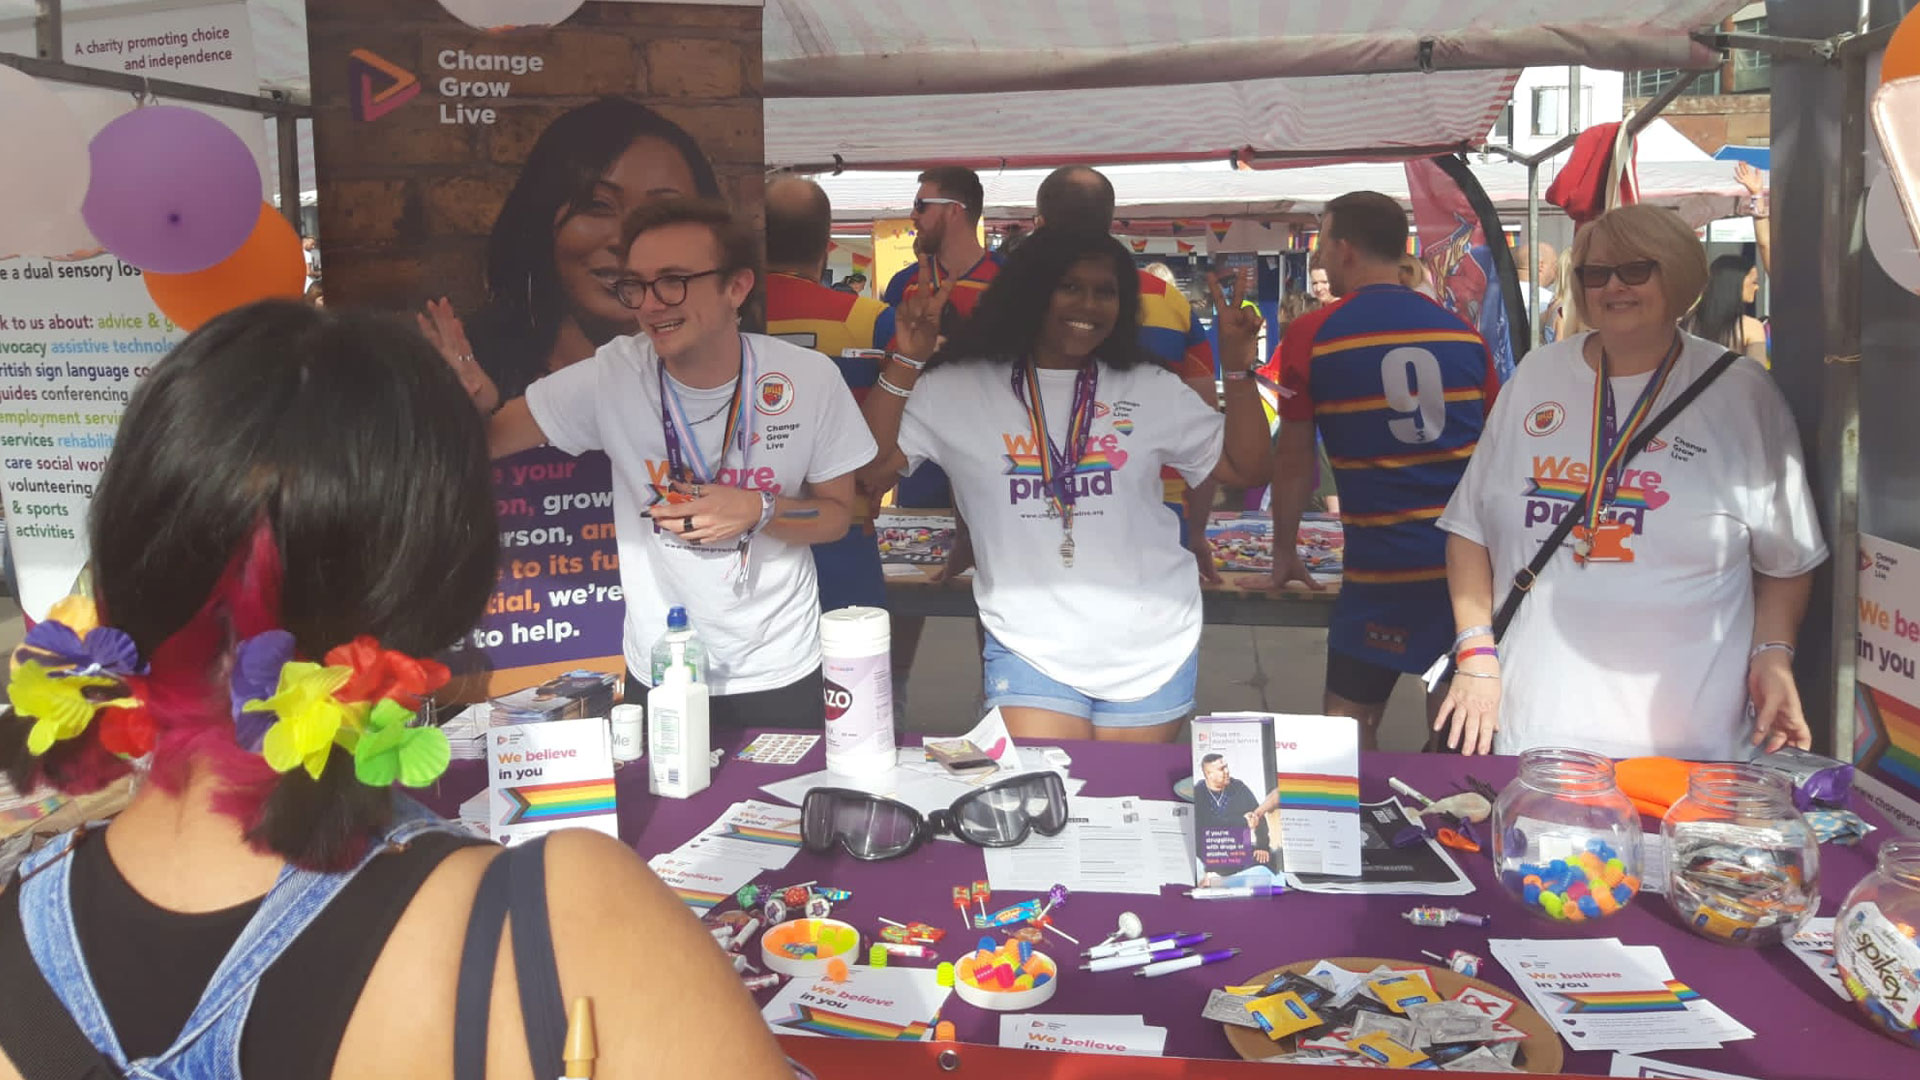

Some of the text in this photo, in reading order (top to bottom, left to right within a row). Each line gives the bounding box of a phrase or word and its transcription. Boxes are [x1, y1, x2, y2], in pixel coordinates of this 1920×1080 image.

[75, 26, 230, 55] A charity promoting choice
[124, 48, 233, 70] and independence
[438, 50, 544, 75] Change
[439, 77, 511, 98] Grow
[440, 103, 497, 124] Live
[12, 269, 20, 280] a
[23, 262, 53, 280] dual
[57, 264, 113, 282] sensory
[118, 259, 143, 277] los
[12, 317, 26, 330] to
[30, 316, 45, 330] us
[49, 314, 94, 329] about:
[98, 312, 143, 329] advice
[147, 312, 161, 328] &
[0, 341, 47, 358] vocacy
[51, 338, 109, 354] assistive
[35, 362, 63, 382] sign
[67, 362, 129, 382] language
[41, 386, 129, 405] conferencing
[1381, 347, 1446, 444] 9
[0, 432, 54, 447] services
[766, 432, 789, 442] Grow
[766, 441, 785, 450] Live
[5, 455, 109, 472] care social wor
[512, 460, 577, 486] your
[1532, 456, 1662, 489] We re
[8, 477, 93, 499] volunteering
[1010, 470, 1113, 504] prud
[12, 500, 69, 518] & sports
[16, 523, 75, 539] activities
[512, 560, 541, 580] to
[549, 553, 583, 575] its
[1859, 596, 1920, 642] We be
[472, 628, 504, 648] to
[511, 619, 580, 645] help.
[1857, 632, 1914, 680] in you
[498, 749, 577, 764] We believe
[499, 767, 543, 780] in you
[1527, 971, 1623, 980] We believe
[1855, 932, 1909, 1002] spikey
[811, 984, 895, 1007] We believe
[1555, 981, 1589, 989] you
[800, 991, 849, 1010] in you
[1028, 1032, 1058, 1044] We
[1060, 1036, 1128, 1052] believe
